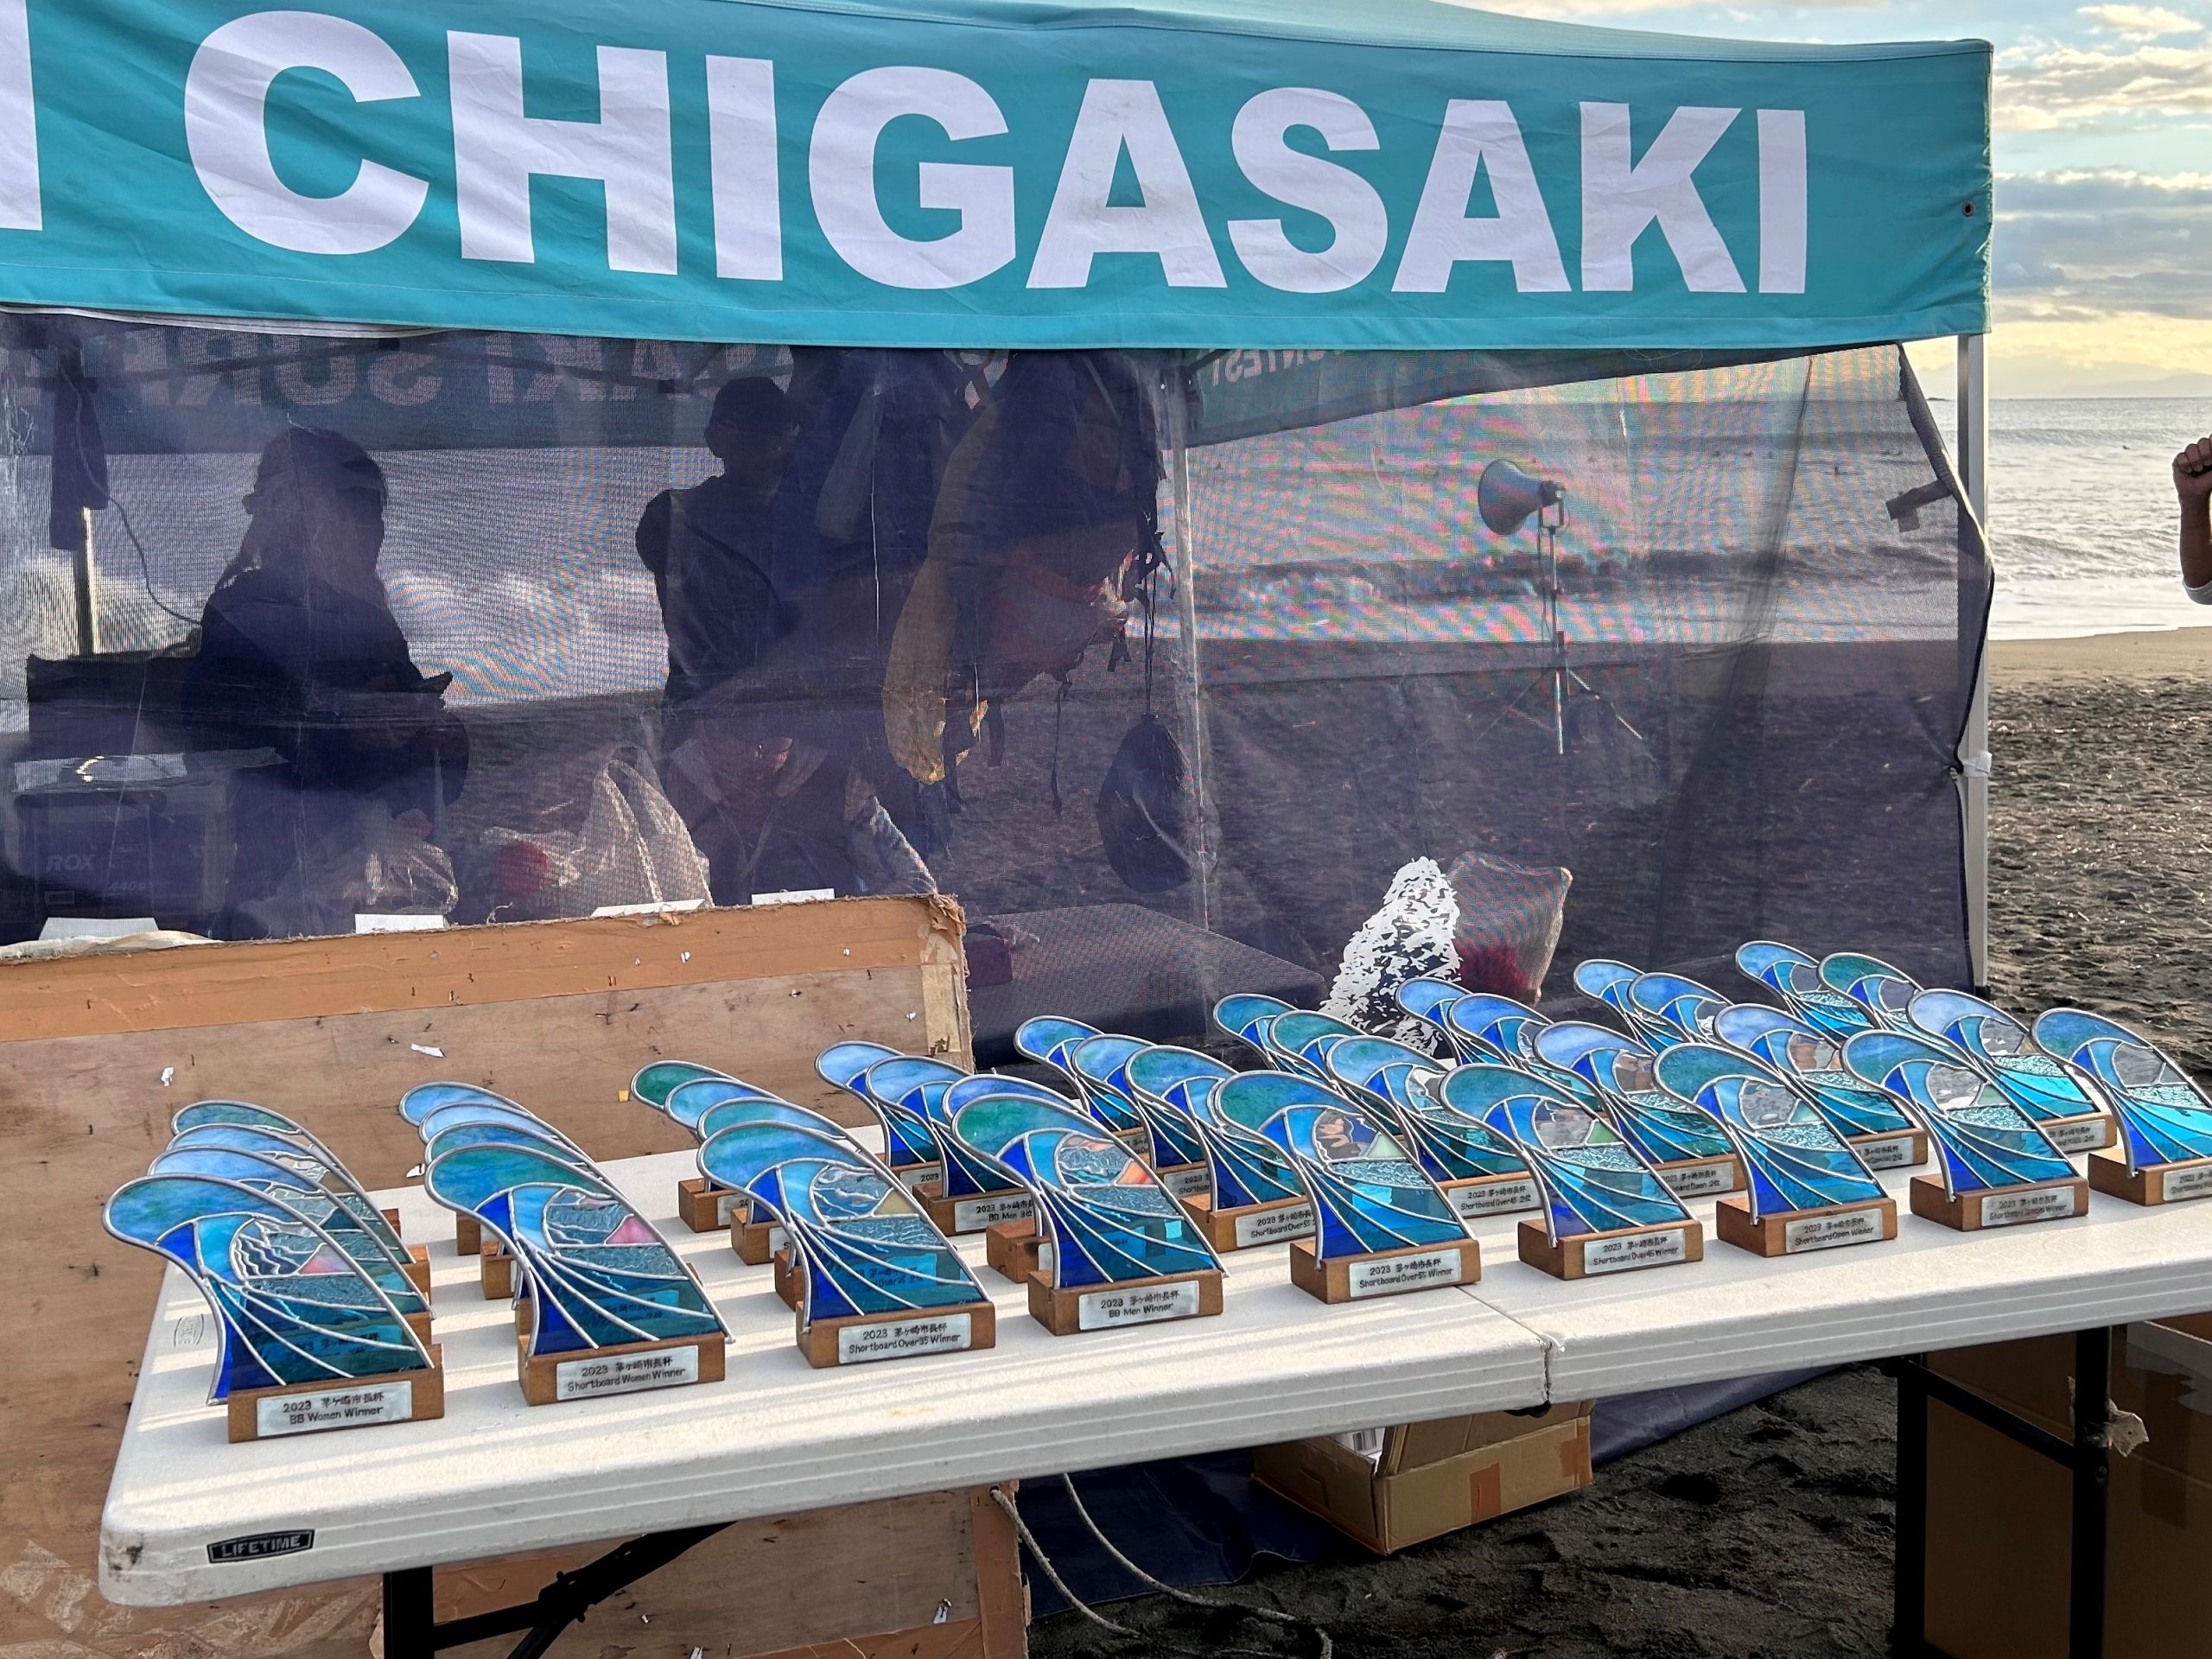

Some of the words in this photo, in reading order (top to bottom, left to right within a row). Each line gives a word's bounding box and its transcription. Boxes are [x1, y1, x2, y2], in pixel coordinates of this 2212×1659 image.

[184, 10, 1807, 295] CHIGASAKI
[920, 1173, 939, 1182] 2023
[1185, 1175, 1203, 1184] 2023
[1179, 1185, 1210, 1195] Shortboar
[1467, 1190, 1486, 1199] 2023
[976, 1205, 995, 1214] 2023
[988, 1213, 1000, 1222] BB
[1001, 1211, 1017, 1220] Men
[1804, 1224, 1822, 1234] 2023
[1832, 1230, 1850, 1241] Open
[1852, 1227, 1874, 1236] Winner
[1603, 1243, 1622, 1253] 2023
[1655, 1247, 1679, 1256] Winner
[1370, 1265, 1391, 1276] 2023
[1427, 1268, 1453, 1278] Winner
[1101, 1299, 1123, 1309] 2023
[1109, 1309, 1121, 1319] BB
[1123, 1306, 1141, 1317] Men
[1143, 1303, 1174, 1314] Winner
[863, 1330, 888, 1340] 2023
[931, 1332, 961, 1344] Winner
[582, 1365, 608, 1377] 2023
[568, 1376, 620, 1392] Shortboard
[621, 1372, 652, 1384] Women
[652, 1368, 685, 1380] Winner
[283, 1400, 312, 1413] 2023
[289, 1413, 305, 1425] BB
[308, 1410, 342, 1422] Women
[345, 1406, 384, 1418] Winner
[220, 1535, 301, 1557] LIFETIME
